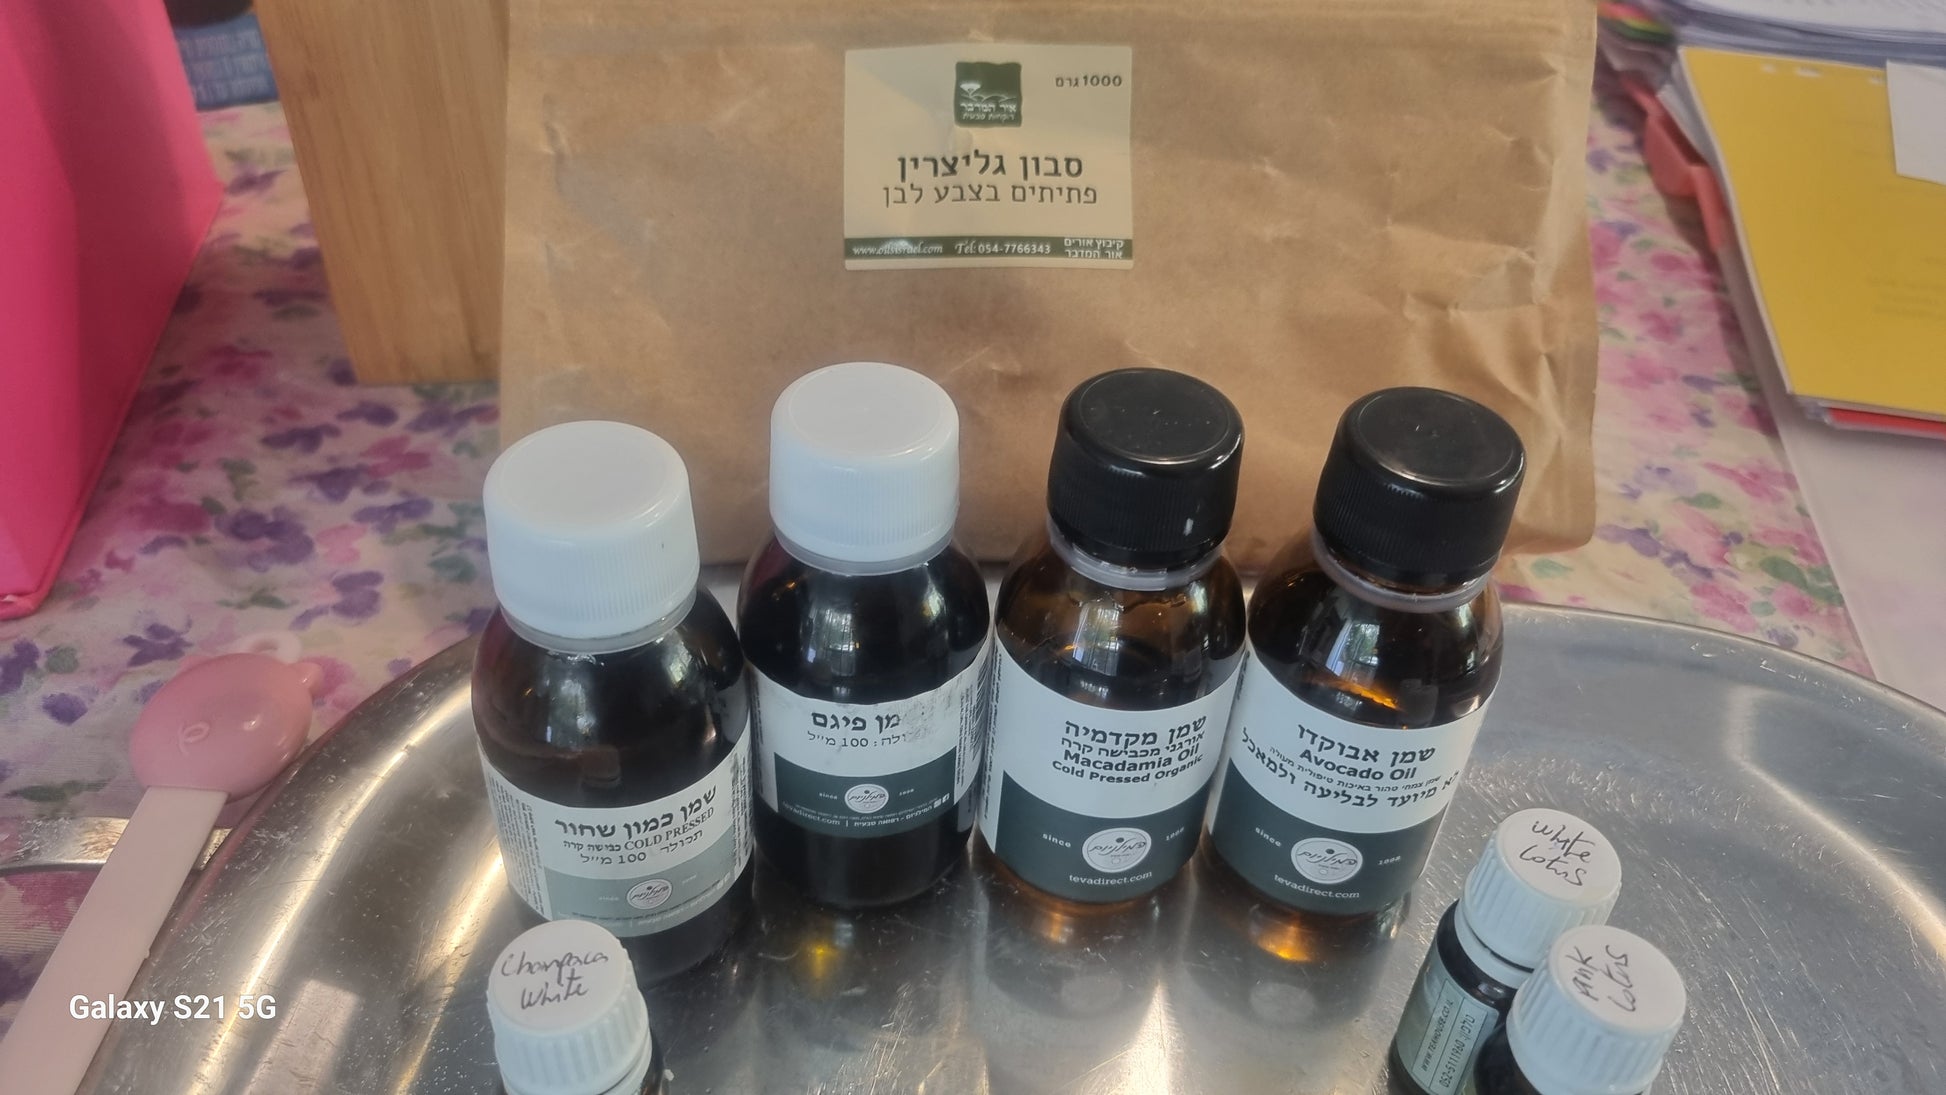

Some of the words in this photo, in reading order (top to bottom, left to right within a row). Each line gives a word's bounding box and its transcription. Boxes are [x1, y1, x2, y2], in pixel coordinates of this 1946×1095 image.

[1055, 77, 1079, 88] גרם
[1082, 75, 1122, 87] 1000
[897, 149, 1007, 183] גליצרין
[1019, 156, 1084, 181] סבון
[883, 183, 924, 208] לבן
[934, 184, 1001, 204] בצבע
[1011, 185, 1098, 204] פתיתים
[978, 242, 1051, 255] 054-7766343
[1064, 239, 1093, 247] אורים
[1095, 239, 1124, 250] קיבוץ
[1065, 250, 1100, 258] המדבר
[1105, 250, 1122, 259] אור
[811, 712, 867, 731] פיגם
[1168, 716, 1207, 745] שמן
[841, 738, 869, 747] 100
[1065, 720, 1158, 750] מקדמיה
[1165, 731, 1205, 753] אורגני
[1298, 724, 1380, 762] אבוקדו
[1063, 750, 1173, 772] Macadamia
[1177, 743, 1199, 762] Oil
[1242, 727, 1296, 784] ולמאכל
[1299, 749, 1384, 780] Avocado
[1390, 767, 1417, 780] Oil
[1390, 747, 1436, 767] שמן
[1052, 760, 1085, 778] Cold
[1089, 771, 1150, 783] Pressed
[1155, 754, 1203, 780] Organic
[1297, 764, 1334, 783] טיפולית
[1303, 780, 1379, 807] לבליעה
[1337, 780, 1371, 792] באיכות
[1402, 782, 1424, 790] צמחי
[680, 785, 716, 821] שמן
[1387, 786, 1437, 807] מיועד
[554, 820, 616, 837] שחור
[623, 812, 673, 839] כמון
[624, 834, 662, 850] COLD
[665, 807, 714, 840] PRESSED
[1042, 832, 1071, 848] since
[618, 852, 647, 864] 100
[1069, 871, 1152, 885] tevadirect.com
[1274, 874, 1360, 898] tevadirect.com
